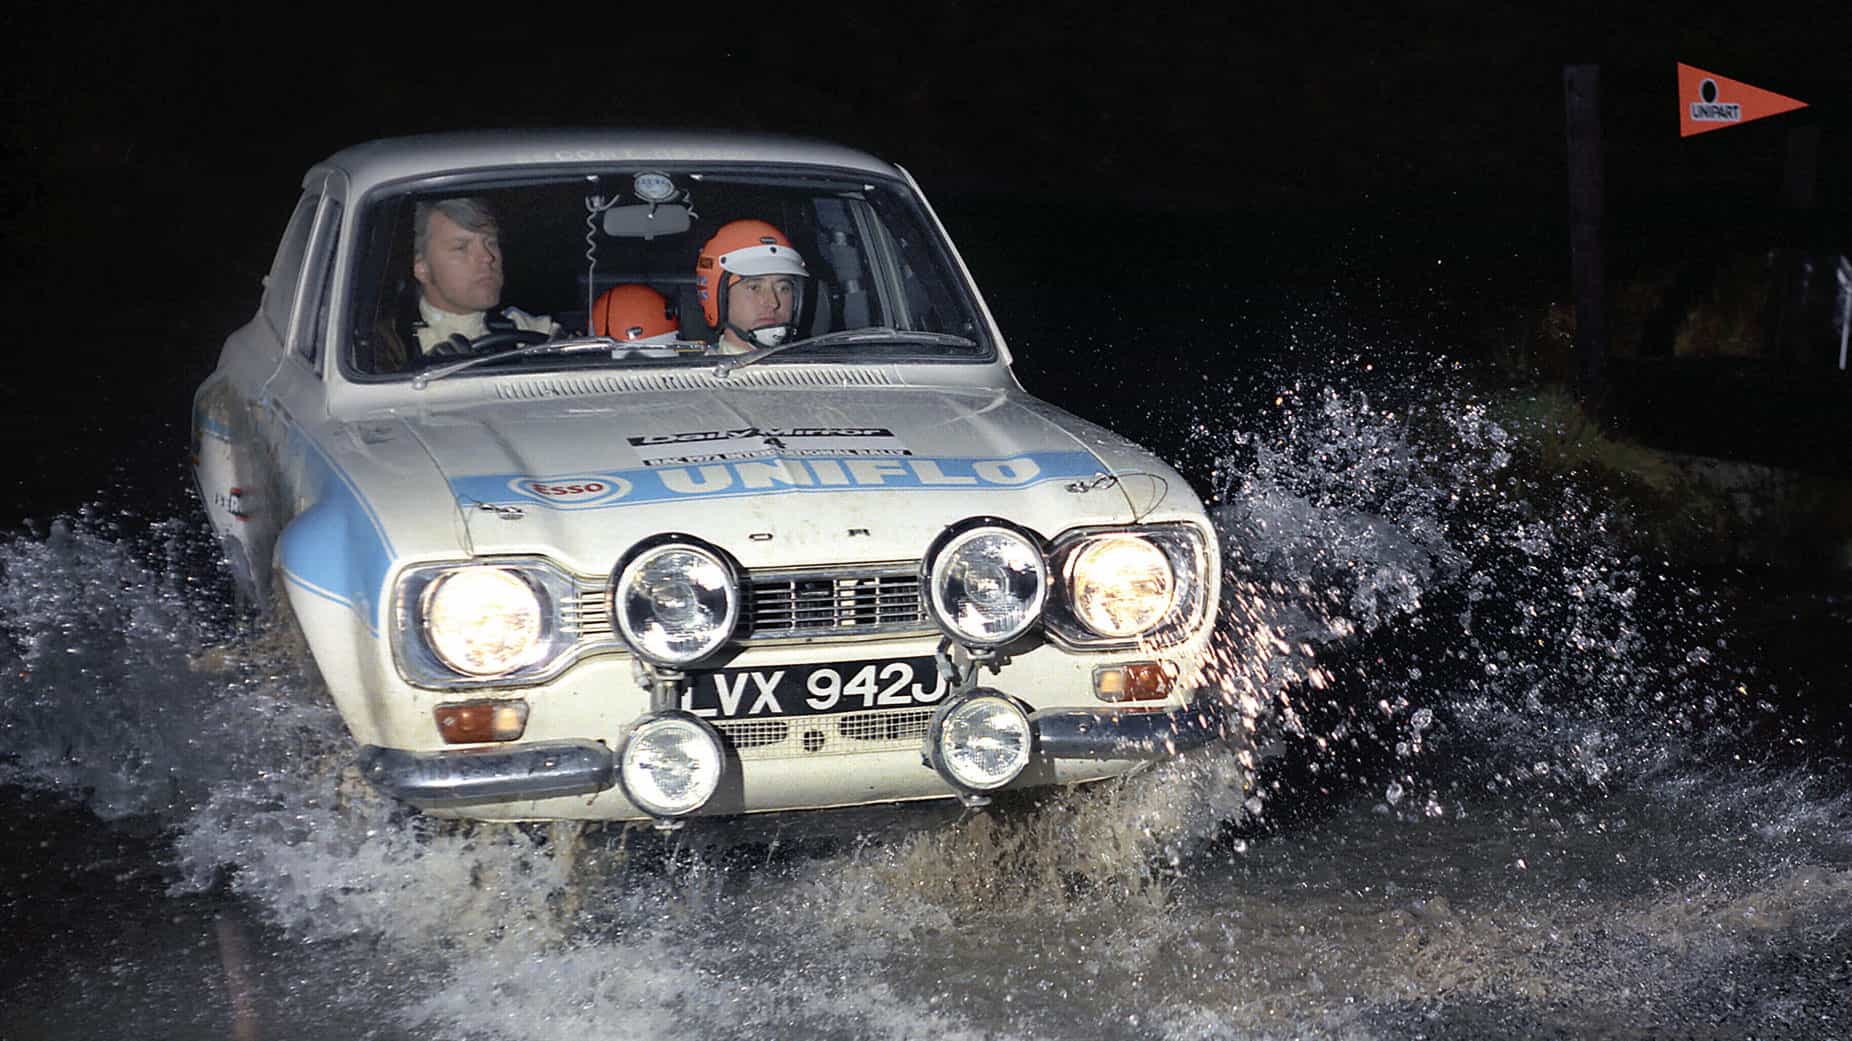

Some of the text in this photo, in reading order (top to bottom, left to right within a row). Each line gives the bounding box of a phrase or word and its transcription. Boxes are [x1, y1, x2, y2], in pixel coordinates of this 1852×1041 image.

[1692, 104, 1739, 119] UNIPART
[661, 459, 1041, 492] UNIFLO
[805, 662, 947, 710] 942J
